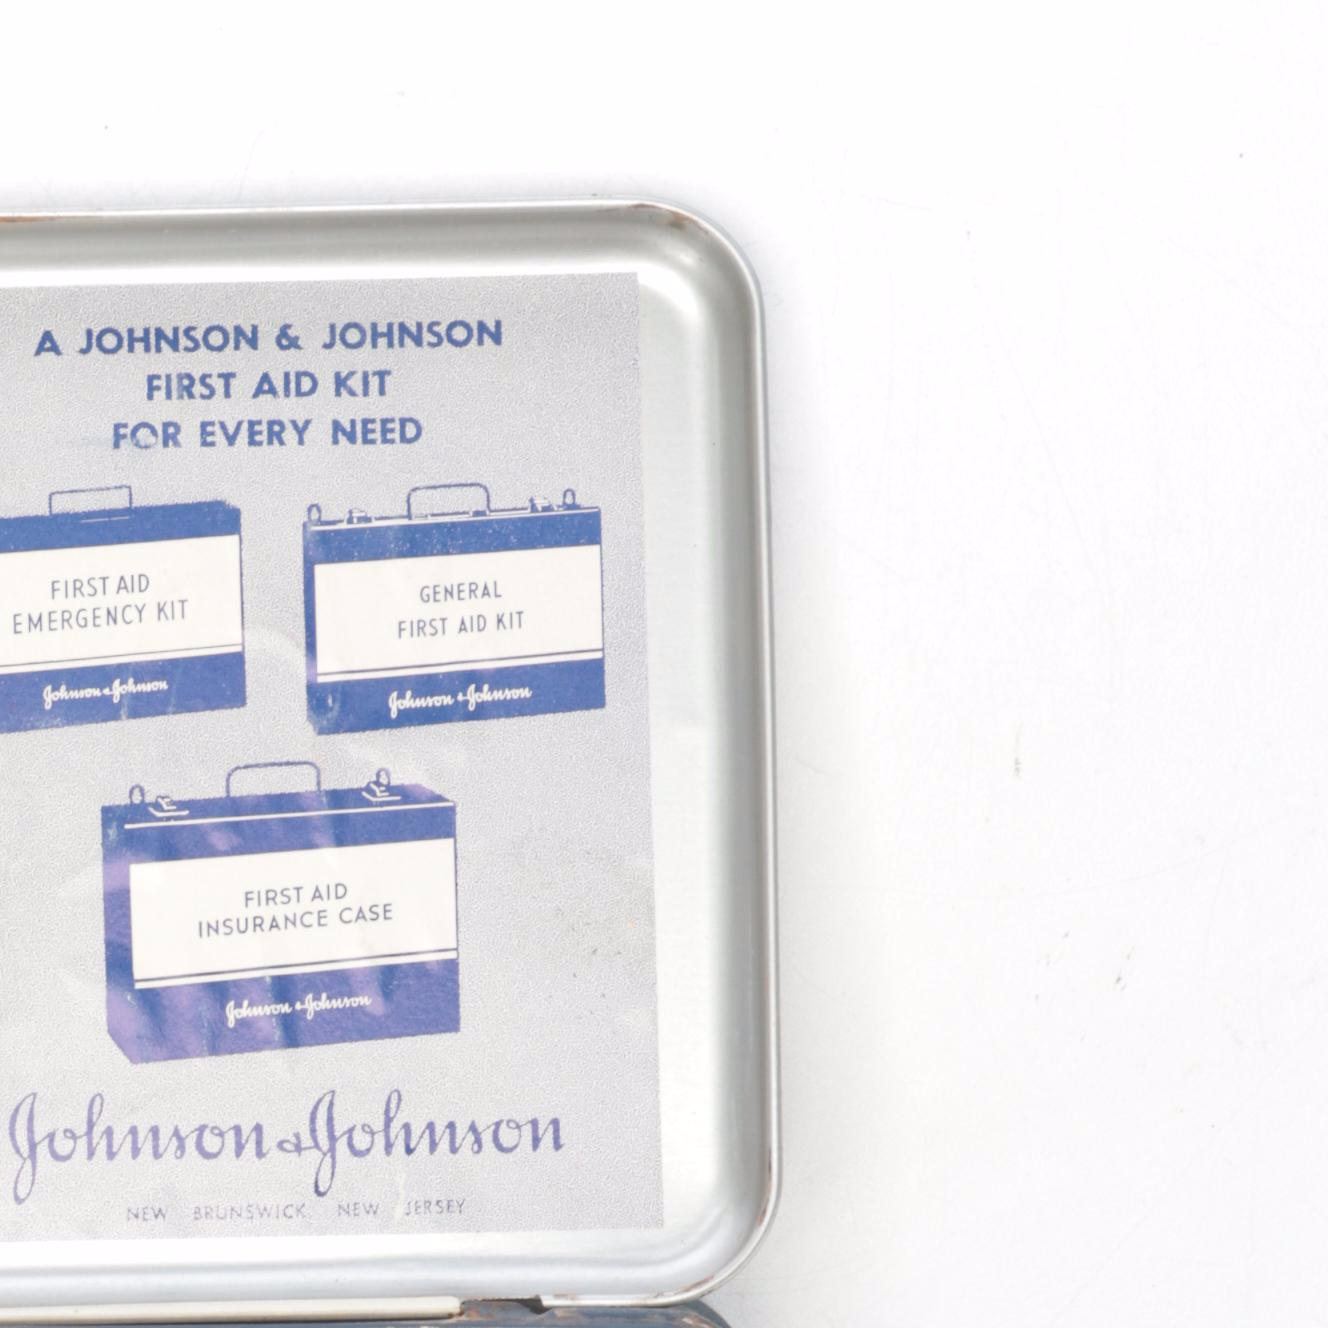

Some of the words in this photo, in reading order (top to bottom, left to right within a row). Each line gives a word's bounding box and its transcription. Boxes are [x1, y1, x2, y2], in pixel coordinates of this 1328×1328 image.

[34, 330, 62, 356] A
[79, 324, 258, 355] JOHNSON
[275, 324, 302, 350] &
[322, 320, 502, 349] JOHNSON
[147, 372, 236, 400] FIRST
[252, 371, 318, 399] AID
[334, 370, 391, 397] KIT
[113, 421, 181, 449] FOR
[200, 419, 311, 447] EVERY
[332, 417, 422, 445] NEED
[51, 576, 110, 599] FIRST
[116, 573, 151, 594] AID
[419, 581, 503, 603] GENERAL
[13, 604, 146, 635] EMERGENCY
[157, 599, 187, 621] KIT
[398, 617, 448, 638] FIRST
[458, 614, 488, 633] AID
[496, 610, 525, 630] KIT
[43, 684, 102, 710] Johnson
[112, 678, 168, 704] Johnson
[388, 690, 454, 719] Johnson
[466, 683, 533, 711] Johnson
[244, 886, 304, 908] FIRST
[311, 882, 349, 902] AID
[198, 909, 328, 937] INSURANCE
[339, 903, 393, 924] CASE
[225, 999, 293, 1028] Johnson
[305, 992, 372, 1020] Johnson
[9, 1092, 269, 1205] Johnson
[308, 1089, 565, 1198] Johnson
[128, 1208, 165, 1221] NEW
[339, 1203, 377, 1216] NEW
[406, 1200, 464, 1215] JERSEY
